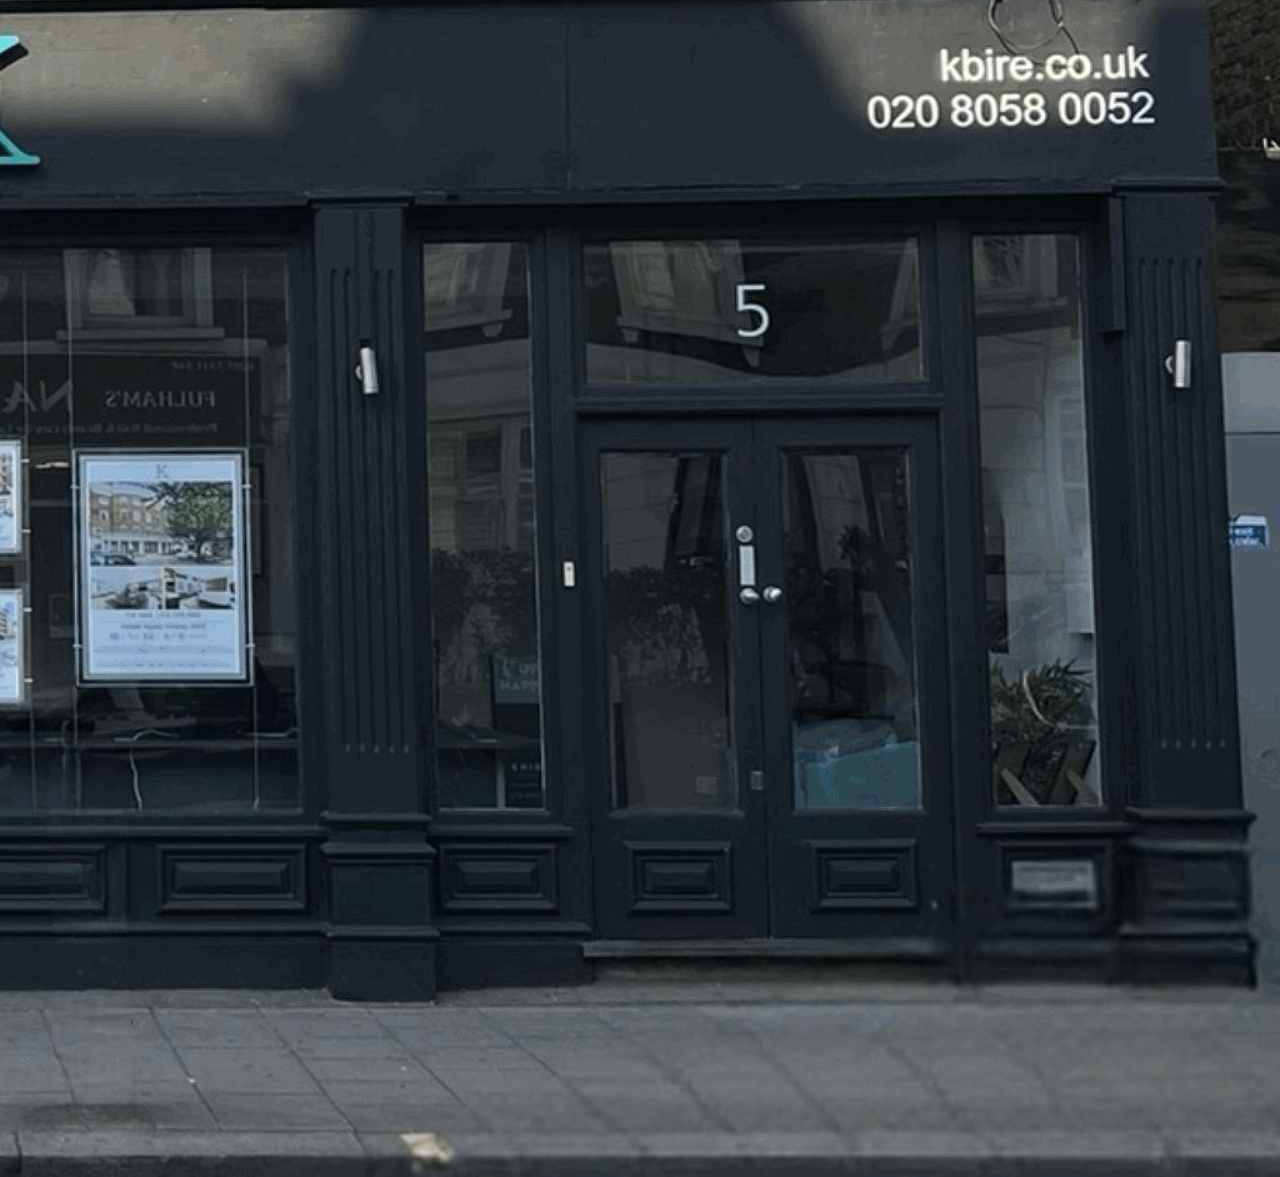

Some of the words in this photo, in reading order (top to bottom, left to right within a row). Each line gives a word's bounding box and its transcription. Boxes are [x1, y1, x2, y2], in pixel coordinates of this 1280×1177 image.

[940, 46, 1150, 82] kbire.co.uk
[867, 95, 939, 128] 020
[950, 93, 1047, 127] 8058
[1058, 91, 1155, 125] 0052
[736, 284, 770, 337] 5
